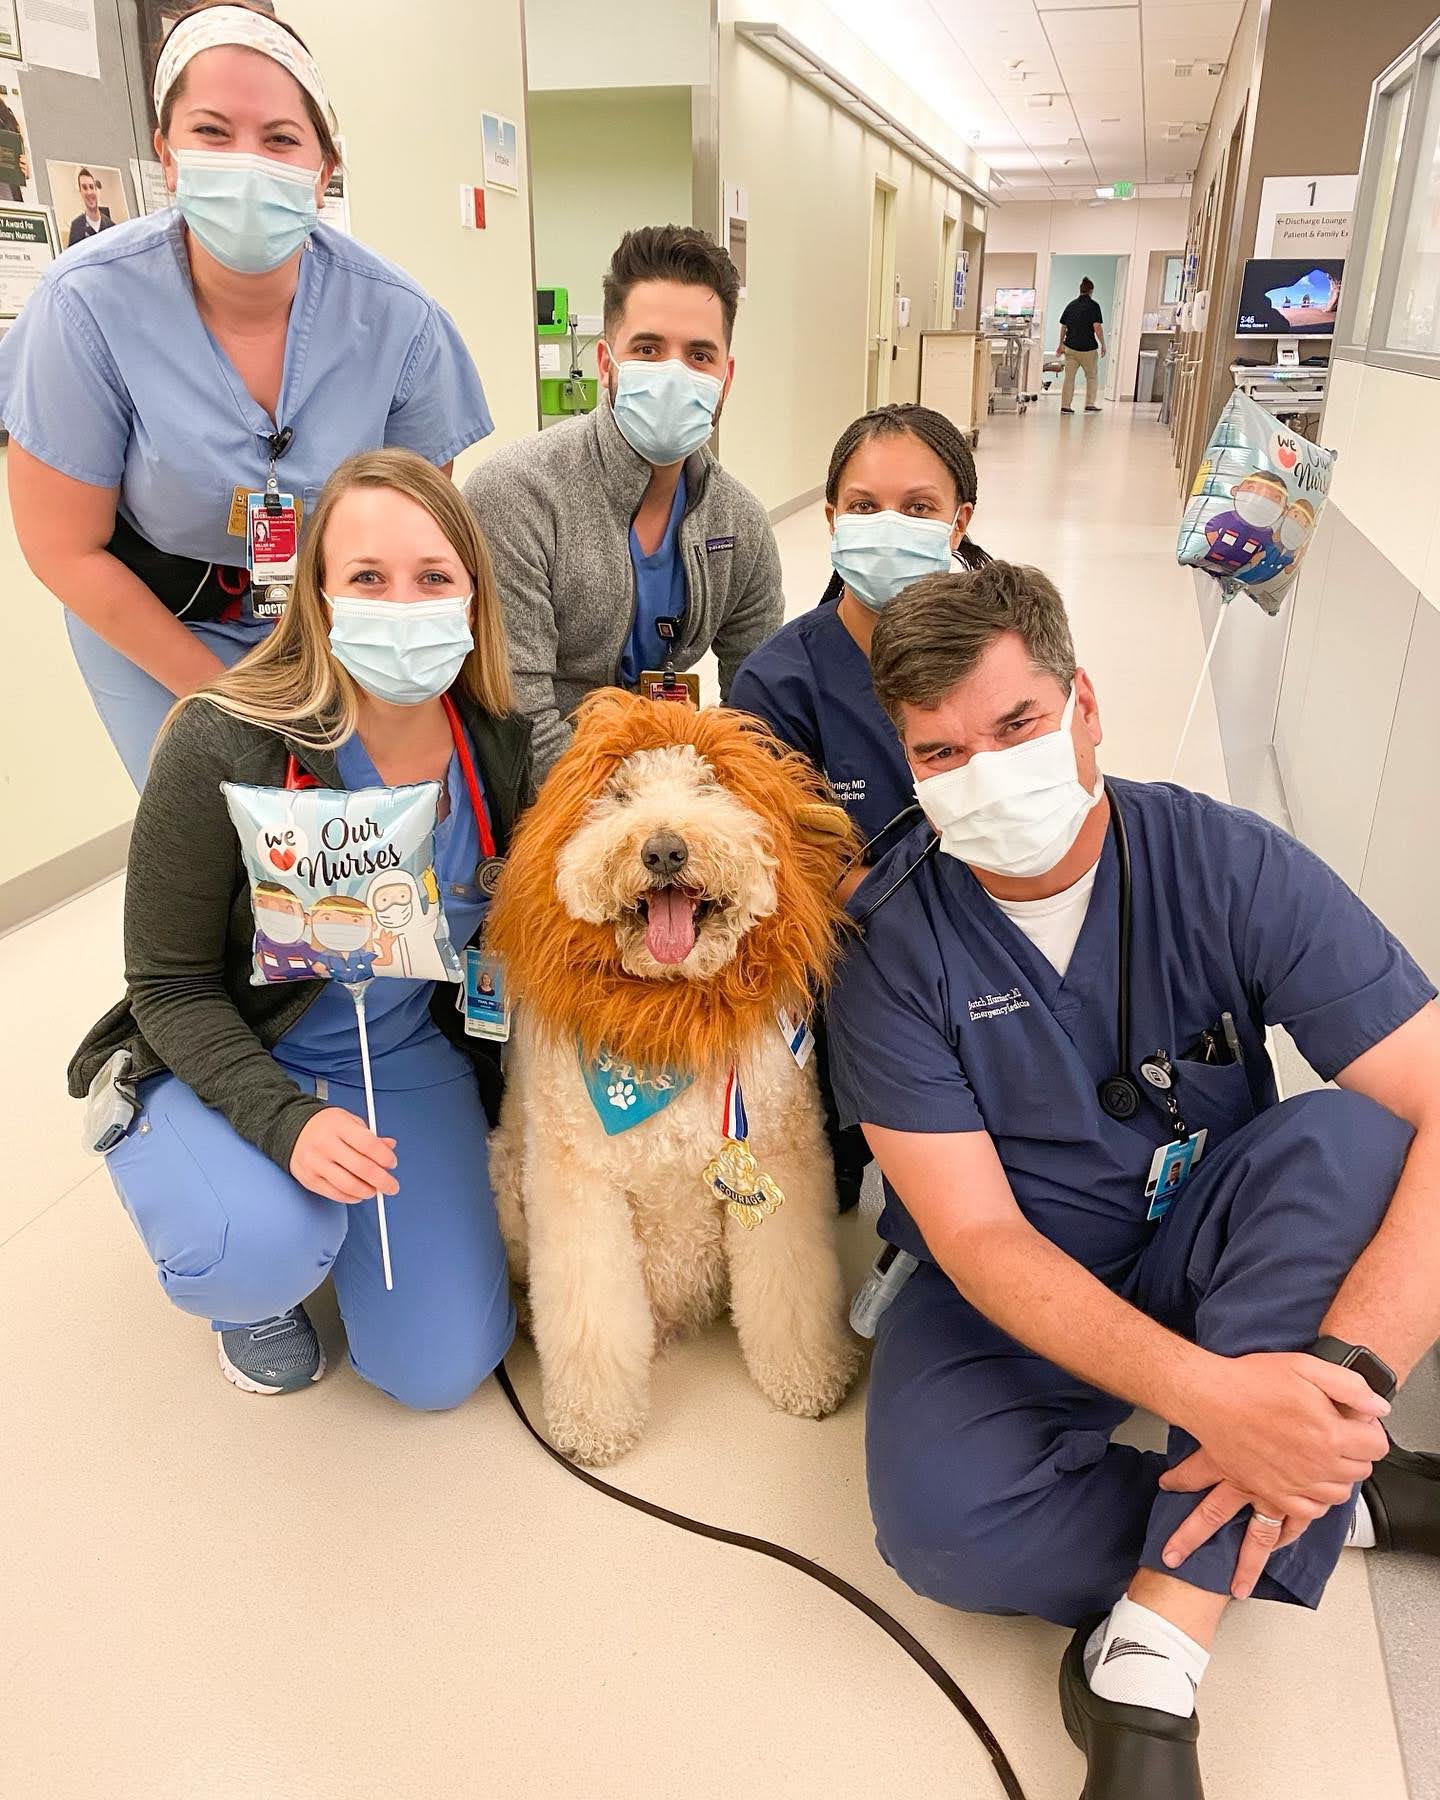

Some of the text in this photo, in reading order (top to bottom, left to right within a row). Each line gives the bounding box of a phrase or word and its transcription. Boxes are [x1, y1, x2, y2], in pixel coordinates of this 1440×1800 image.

[1307, 181, 1317, 206] 1
[5, 219, 25, 229] Award
[1285, 217, 1347, 225] Discharge Lounge
[1283, 230, 1308, 238] Patient
[1316, 230, 1340, 238] Family
[258, 603, 287, 615] DOCTO
[851, 779, 866, 789] MD
[834, 791, 866, 800] edicine
[321, 817, 384, 851] Our
[296, 843, 402, 889] Nurses
[719, 1183, 764, 1205] COURAGE
